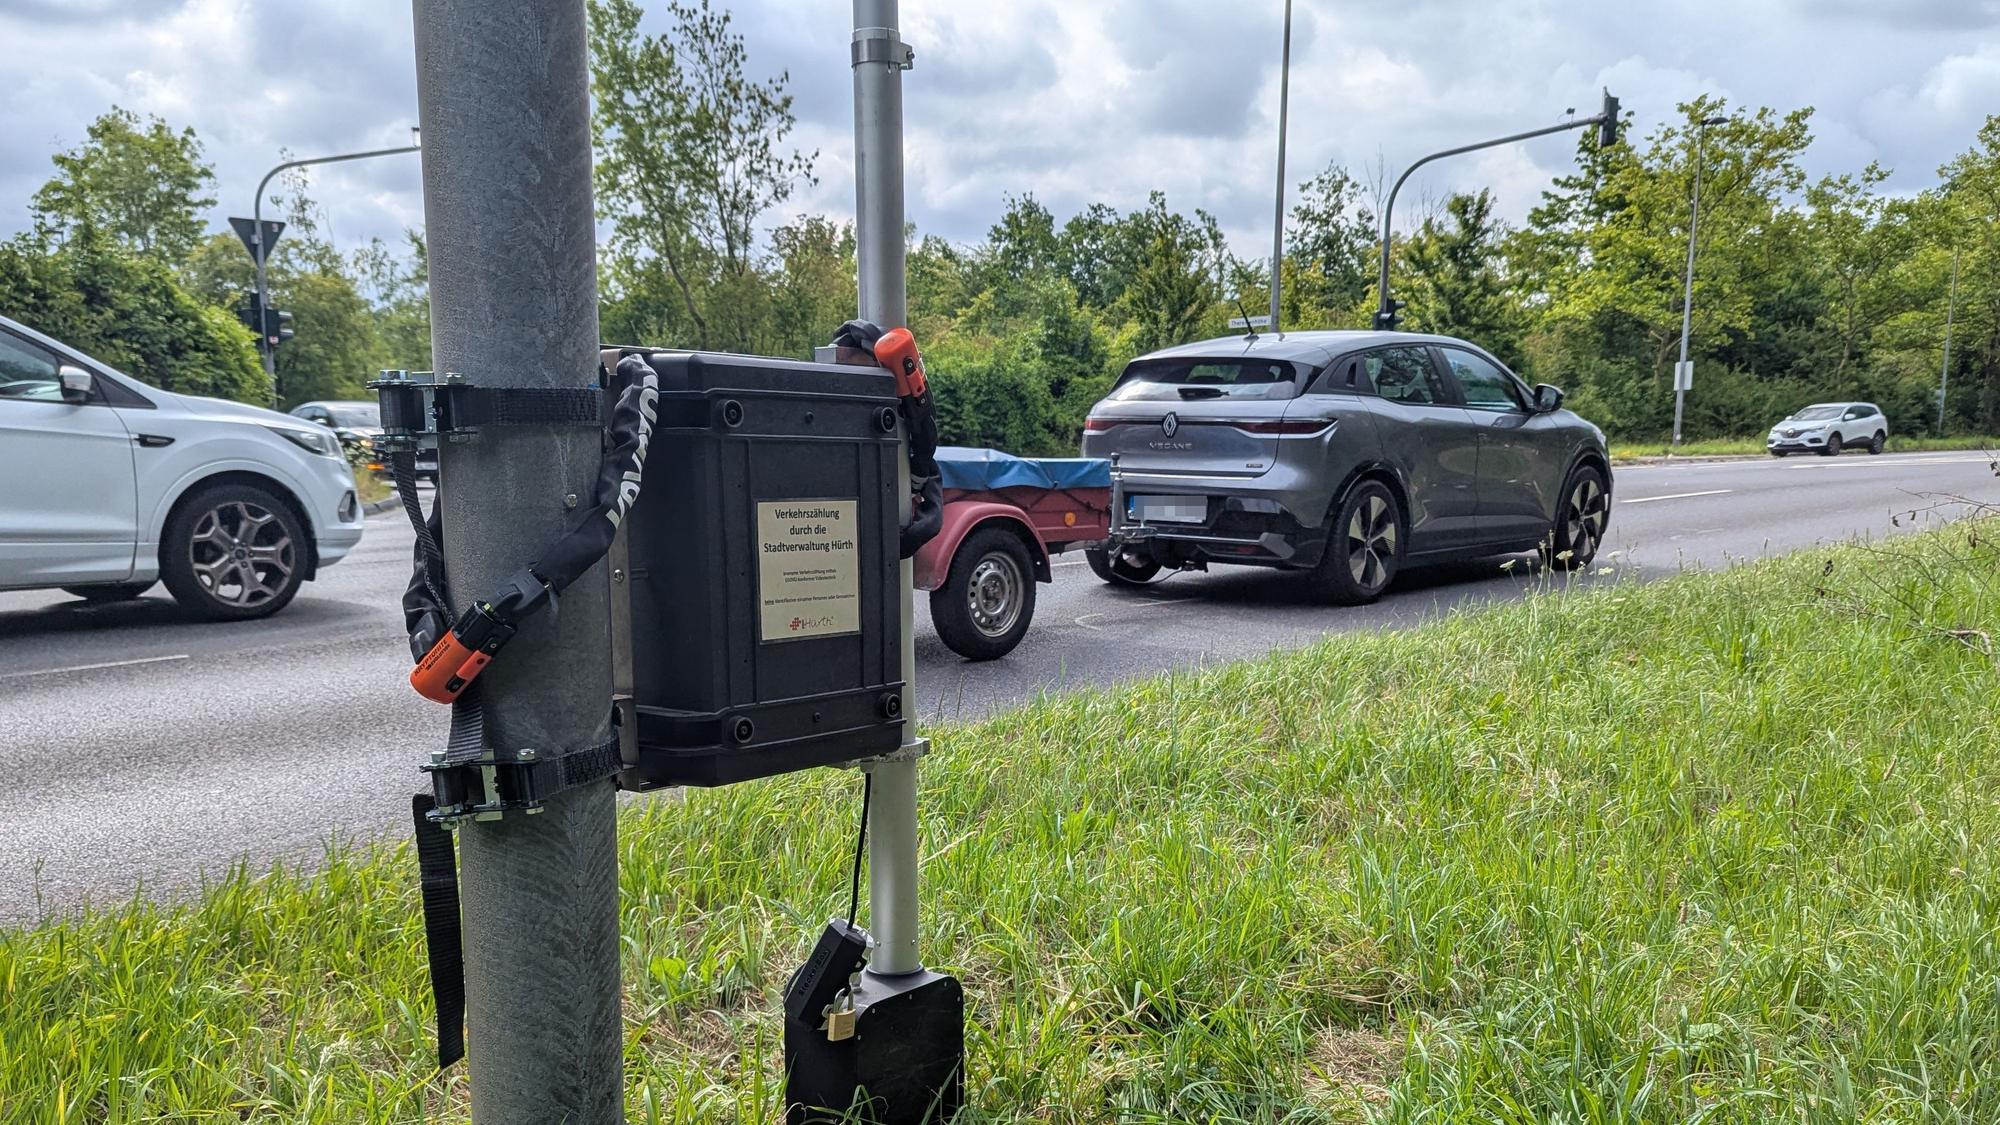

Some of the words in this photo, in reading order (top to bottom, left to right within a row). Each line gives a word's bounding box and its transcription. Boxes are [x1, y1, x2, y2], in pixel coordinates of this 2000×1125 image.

[775, 507, 840, 520] Verkehrszählung
[789, 525, 812, 535] durch
[814, 524, 827, 535] die
[763, 541, 830, 553] Stadtverwaltung
[831, 540, 854, 550] Hürth
[414, 640, 447, 677] KRYPTONITE
